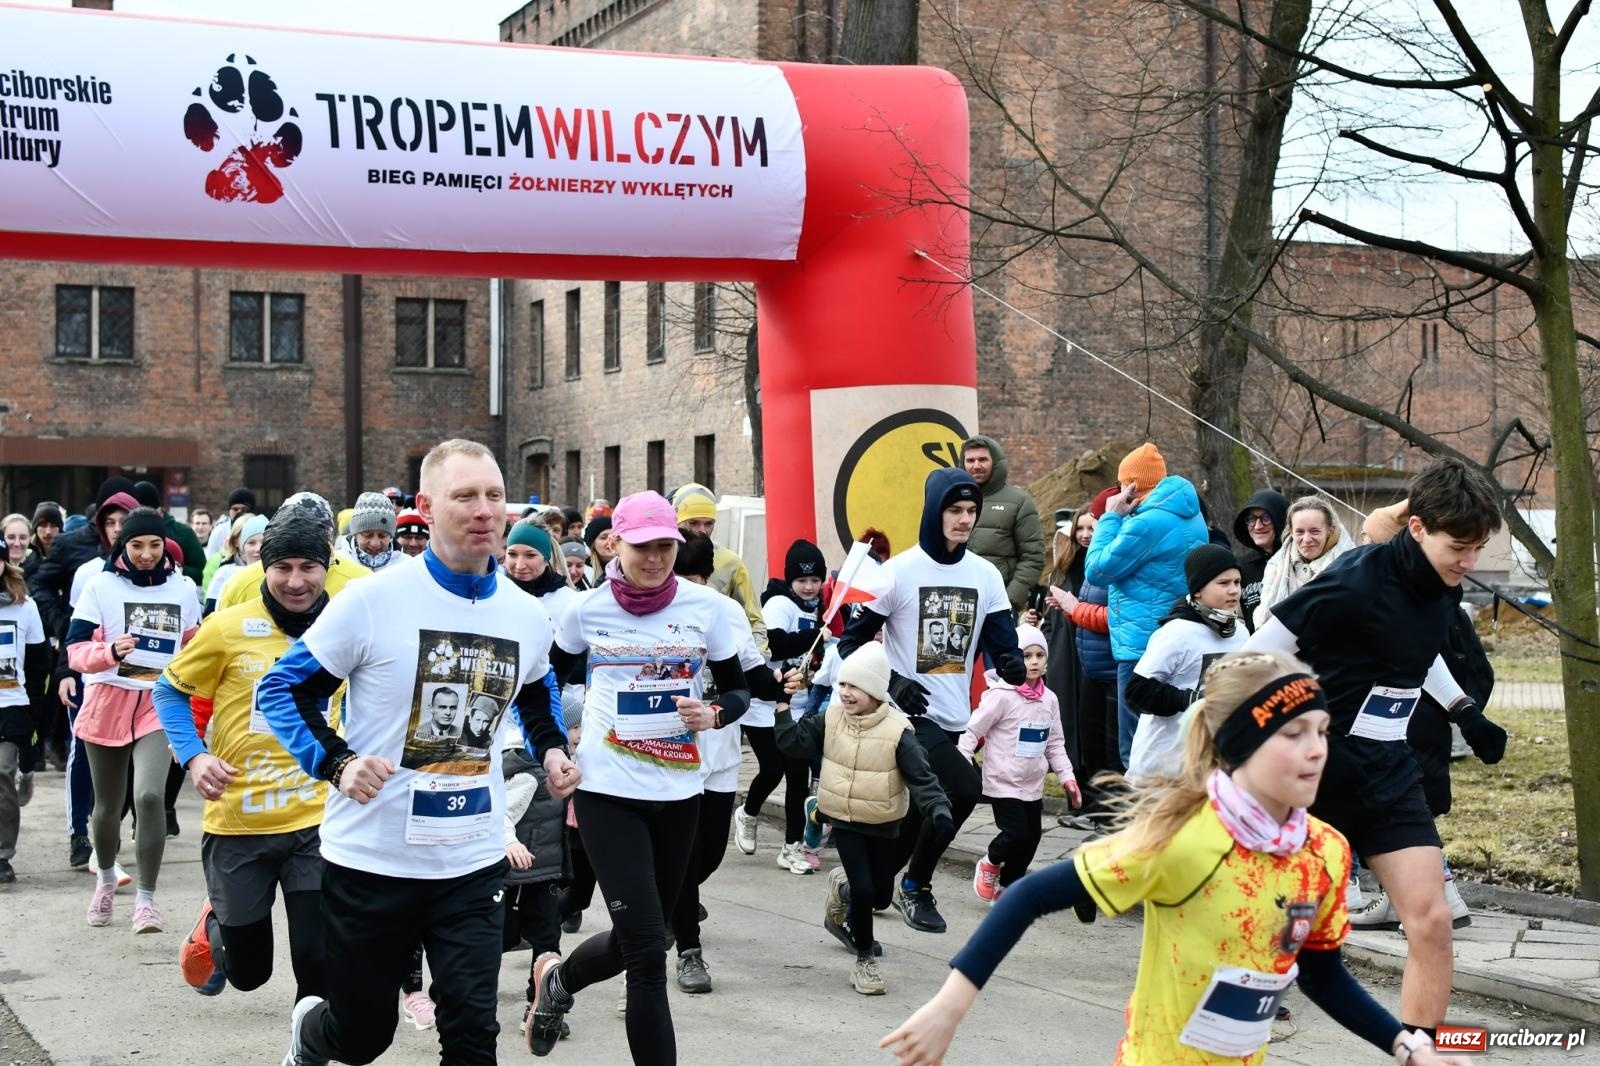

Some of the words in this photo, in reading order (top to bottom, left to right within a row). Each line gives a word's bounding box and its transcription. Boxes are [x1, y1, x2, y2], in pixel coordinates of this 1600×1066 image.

[0, 130, 62, 168] ltury
[367, 169, 416, 185] BIEG
[422, 171, 502, 192] PAMIĘCI
[508, 173, 617, 195] ŻOŁNIERZY
[622, 180, 734, 200] WYKLĘTYCH
[148, 638, 161, 649] 53
[647, 695, 663, 709] 17
[1388, 701, 1403, 714] 41
[447, 795, 467, 811] 39
[1256, 995, 1275, 1015] 11
